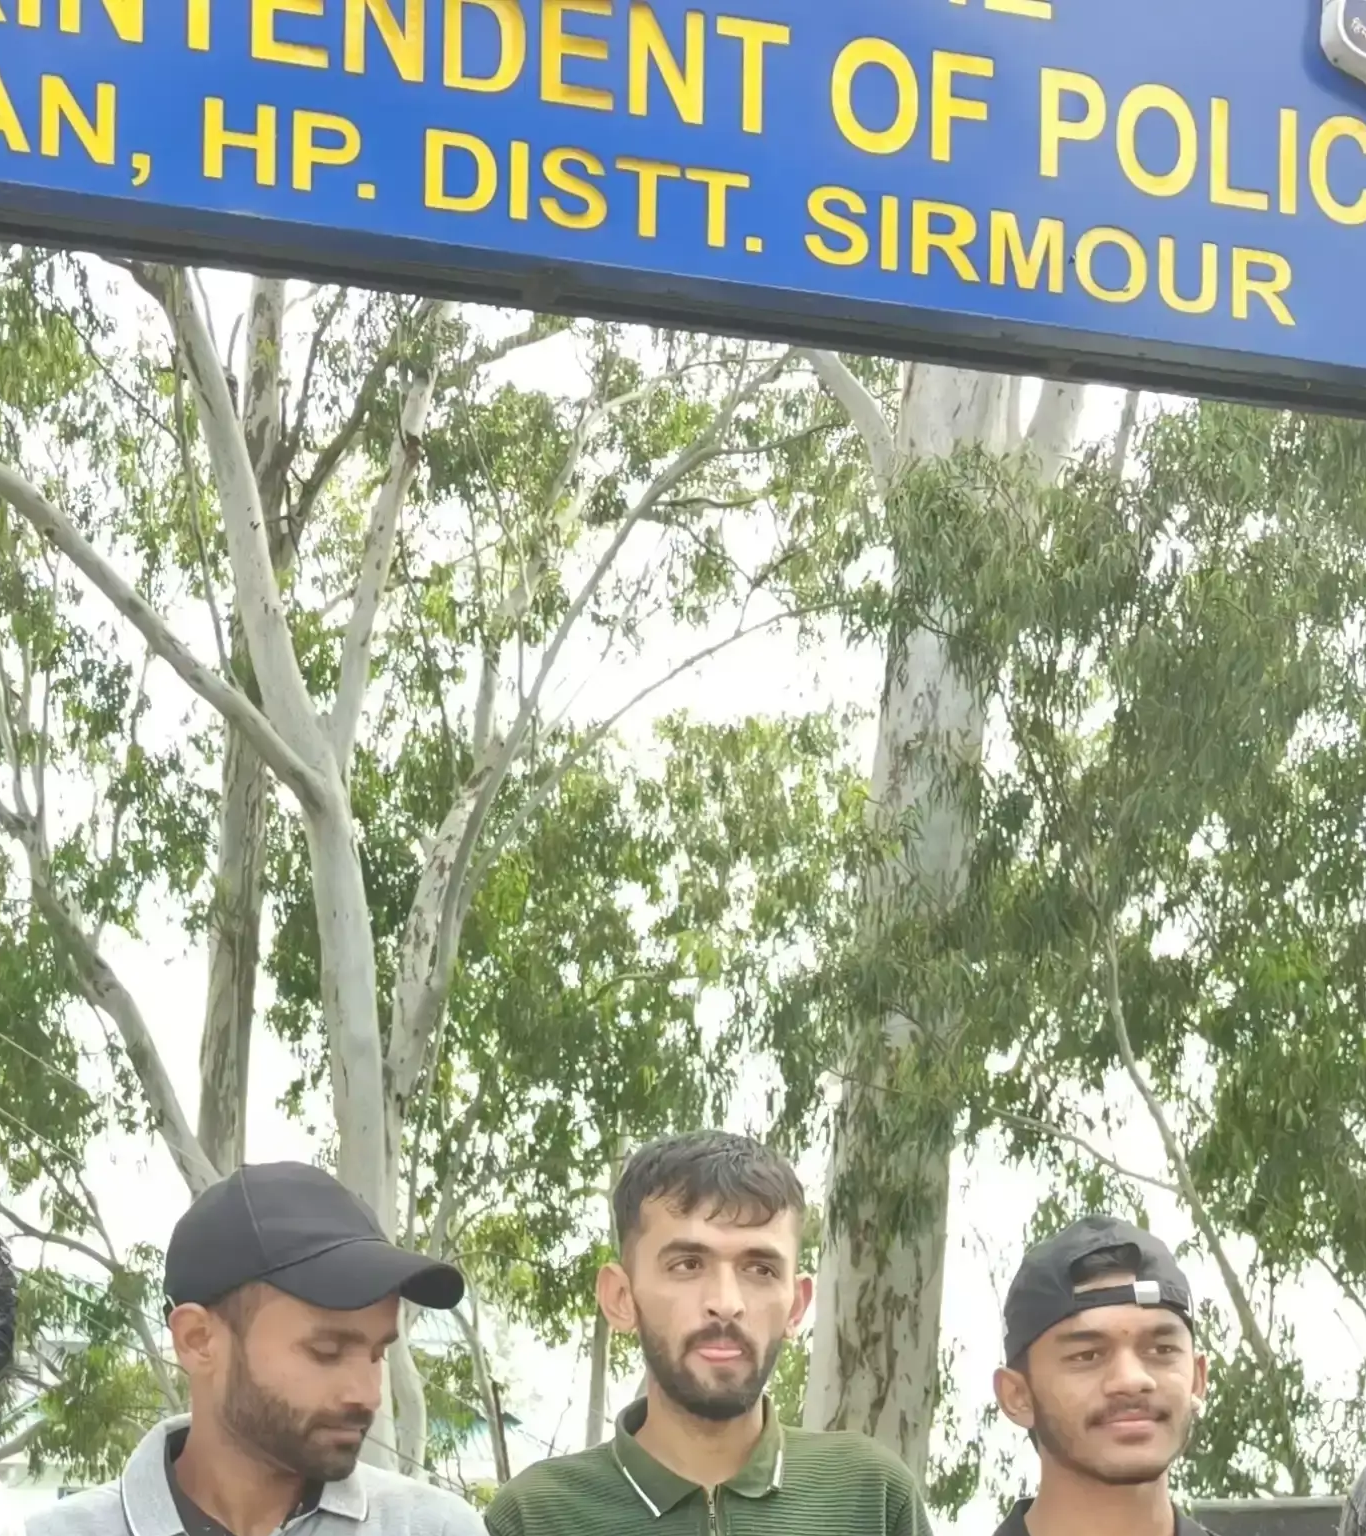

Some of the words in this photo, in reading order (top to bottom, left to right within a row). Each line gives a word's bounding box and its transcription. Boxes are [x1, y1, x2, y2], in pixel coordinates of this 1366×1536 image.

[831, 37, 994, 163] OF
[202, 96, 376, 200] HP.
[423, 128, 763, 254] DISTT.
[804, 184, 1296, 326] SIRMOUR
